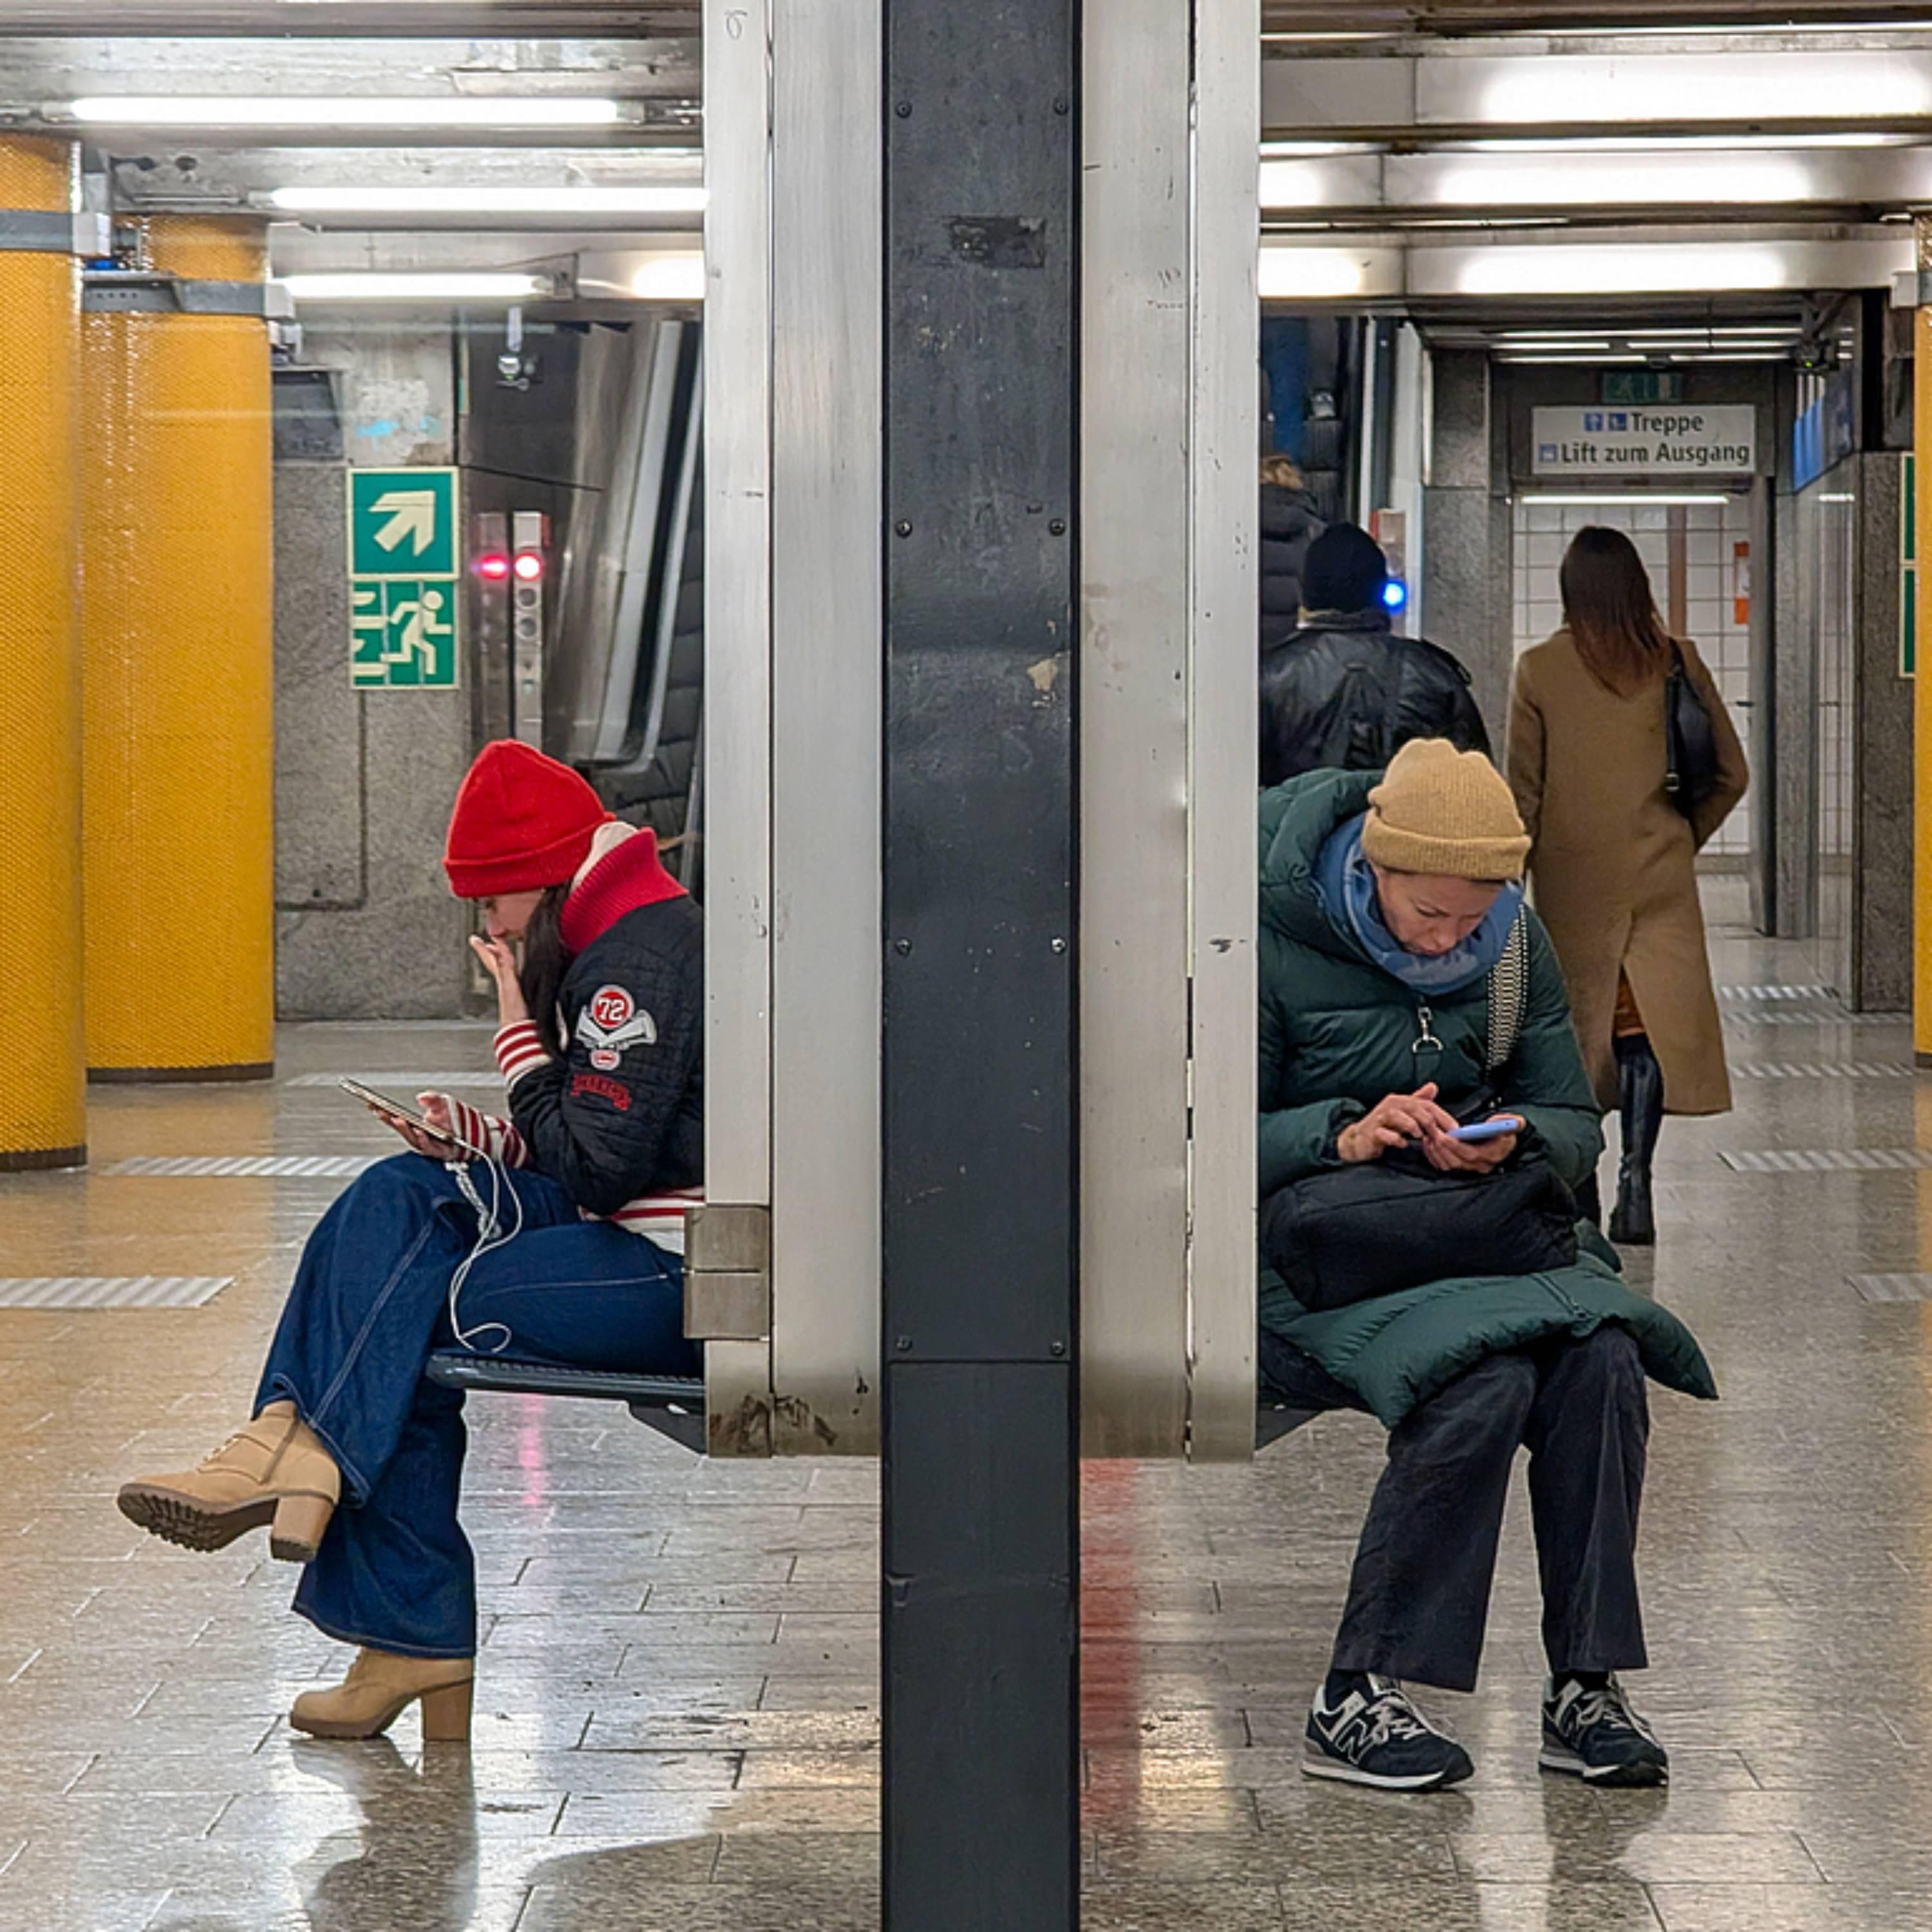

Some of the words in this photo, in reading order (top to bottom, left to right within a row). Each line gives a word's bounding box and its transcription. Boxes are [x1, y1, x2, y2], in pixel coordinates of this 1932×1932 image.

[1631, 413, 1704, 436] Treppe
[1561, 442, 1596, 462] Lift
[1604, 448, 1649, 462] zum
[1655, 442, 1750, 467] Ausgang
[597, 998, 625, 1021] 72
